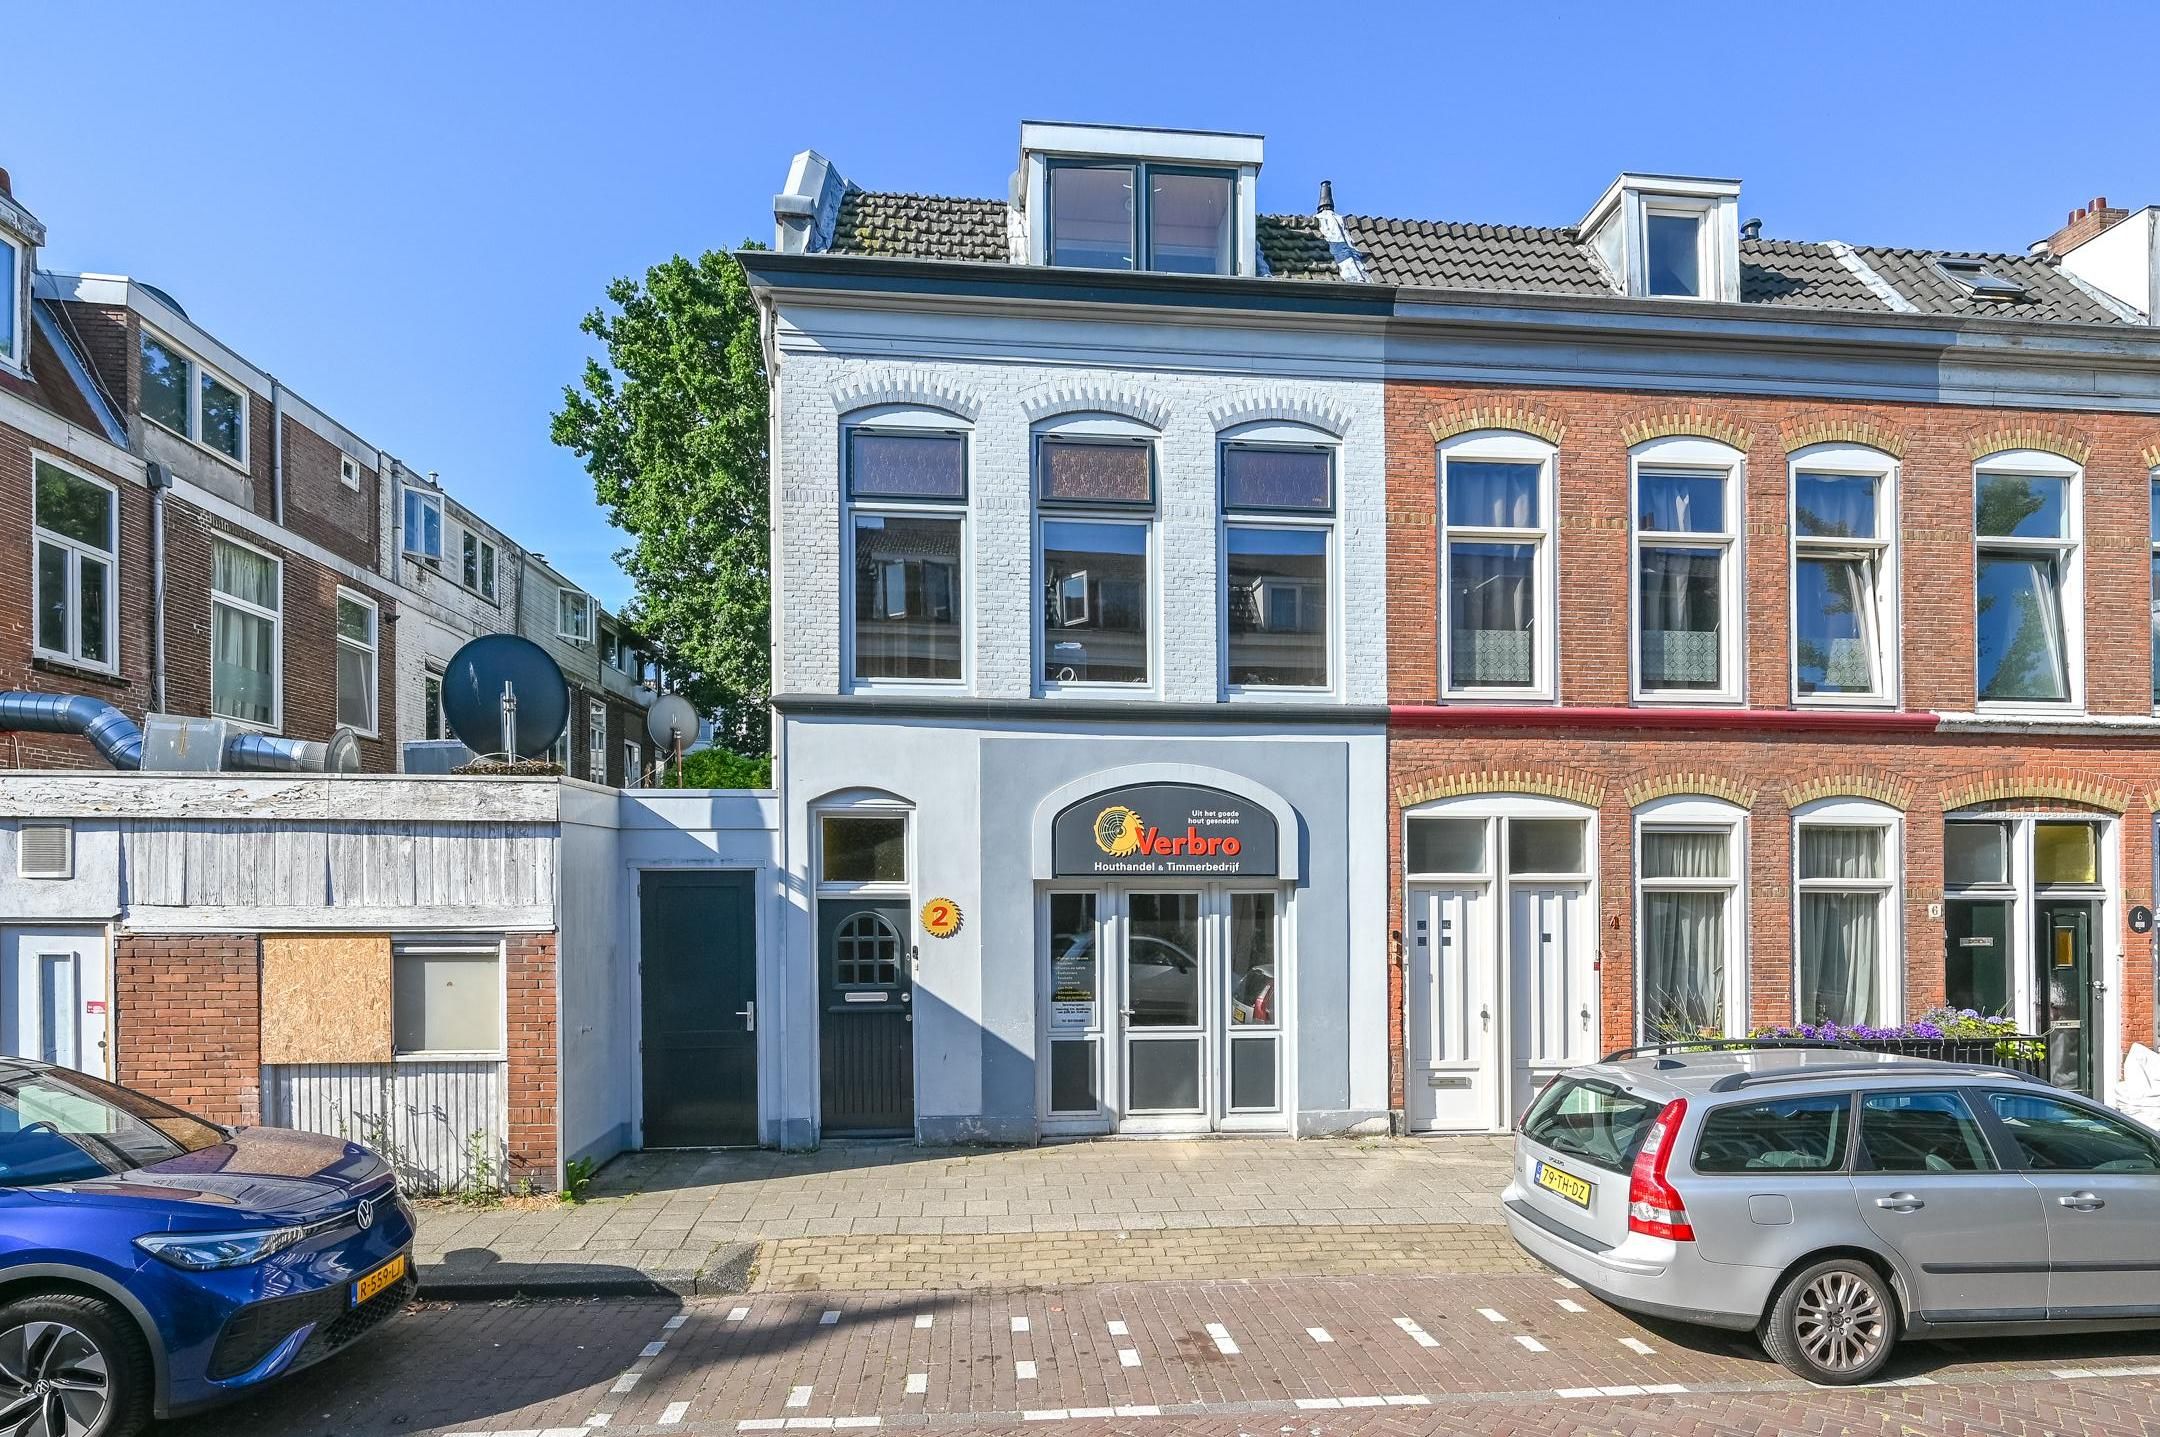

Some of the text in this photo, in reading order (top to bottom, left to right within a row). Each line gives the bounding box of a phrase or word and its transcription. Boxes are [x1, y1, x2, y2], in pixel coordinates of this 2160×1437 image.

[1218, 810, 1239, 819] goede
[1135, 826, 1241, 856] Verbro
[1094, 862, 1155, 871] Houthandel
[1166, 862, 1240, 873] Timmerbedrijf
[932, 906, 948, 926] 2
[1931, 905, 1938, 916] 6
[2137, 911, 2143, 921] 6
